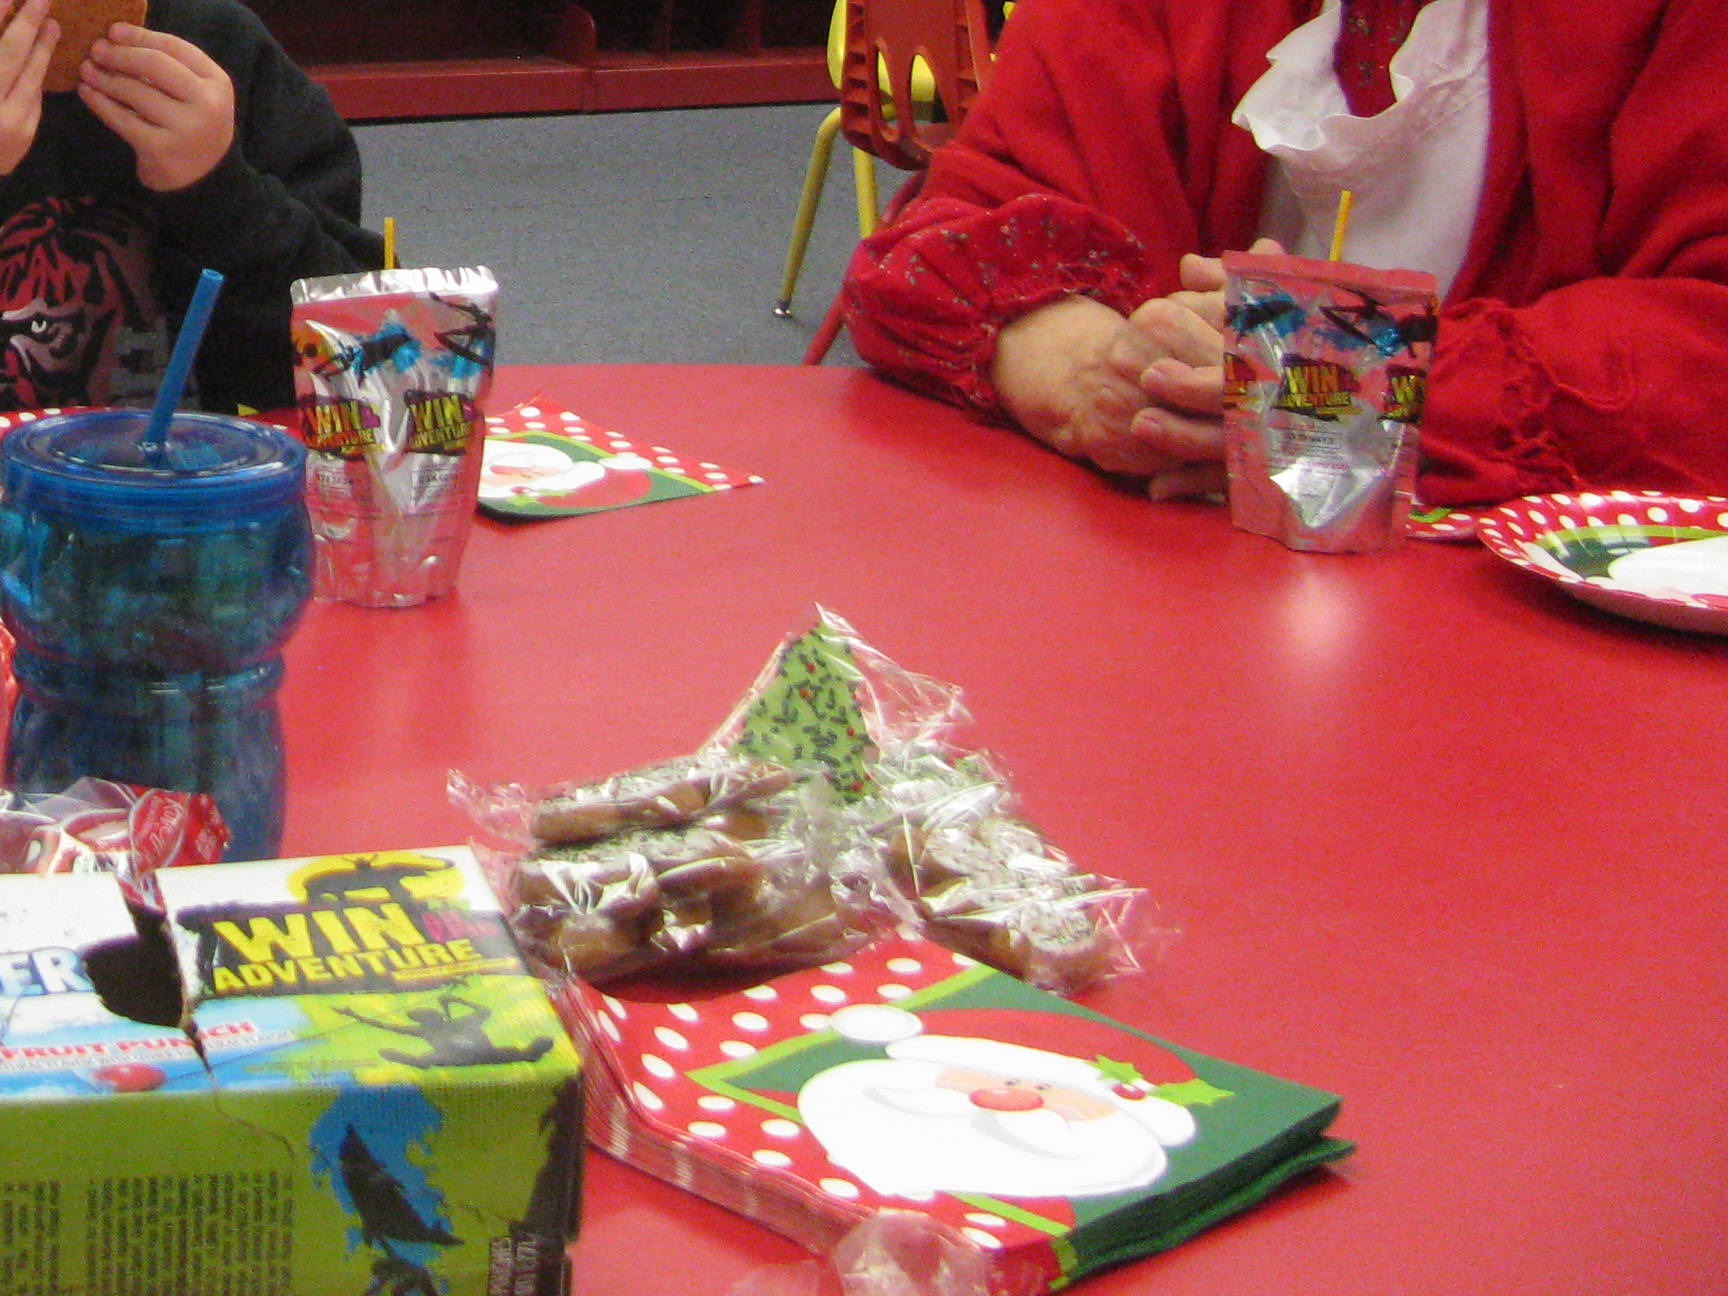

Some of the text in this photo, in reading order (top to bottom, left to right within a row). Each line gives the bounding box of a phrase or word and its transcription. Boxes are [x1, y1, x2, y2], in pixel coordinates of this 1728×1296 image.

[212, 903, 427, 964] WIN
[213, 939, 483, 993] ADVENTURE
[0, 1042, 107, 1059] FRUIT
